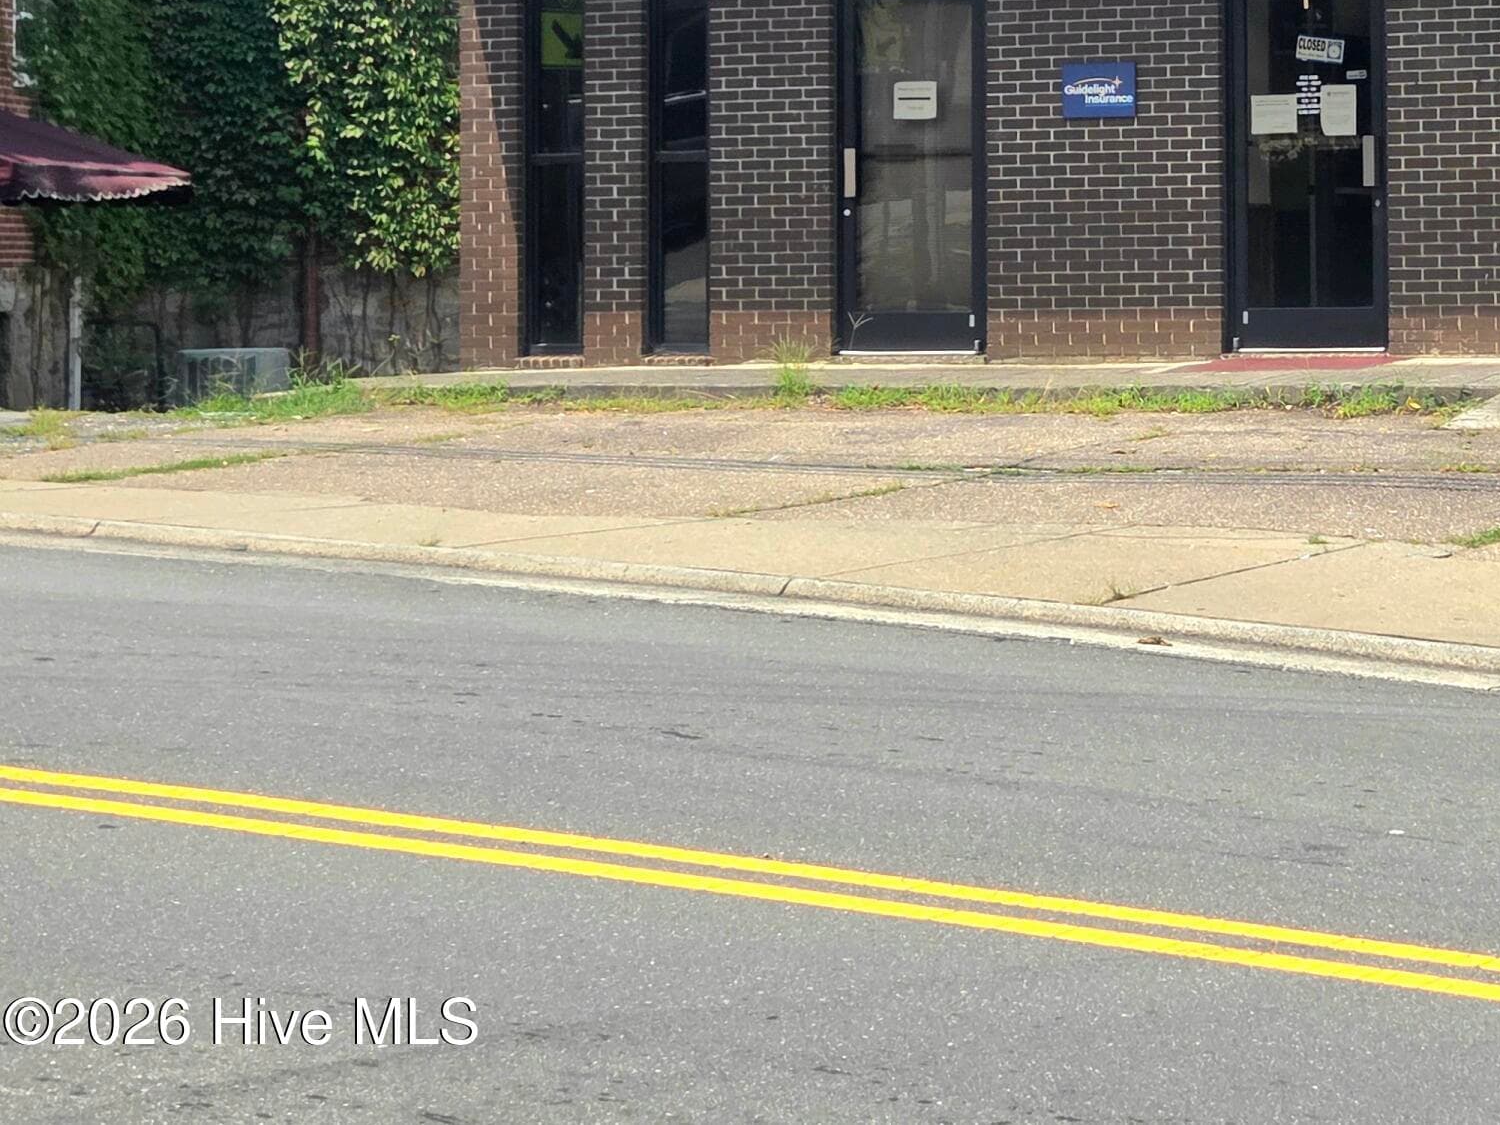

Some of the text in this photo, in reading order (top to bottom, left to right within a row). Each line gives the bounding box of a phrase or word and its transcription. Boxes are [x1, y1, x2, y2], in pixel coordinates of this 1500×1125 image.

[1299, 38, 1326, 51] CLOSED
[1064, 83, 1116, 96] Guidelight
[1084, 94, 1134, 104] Insurance
